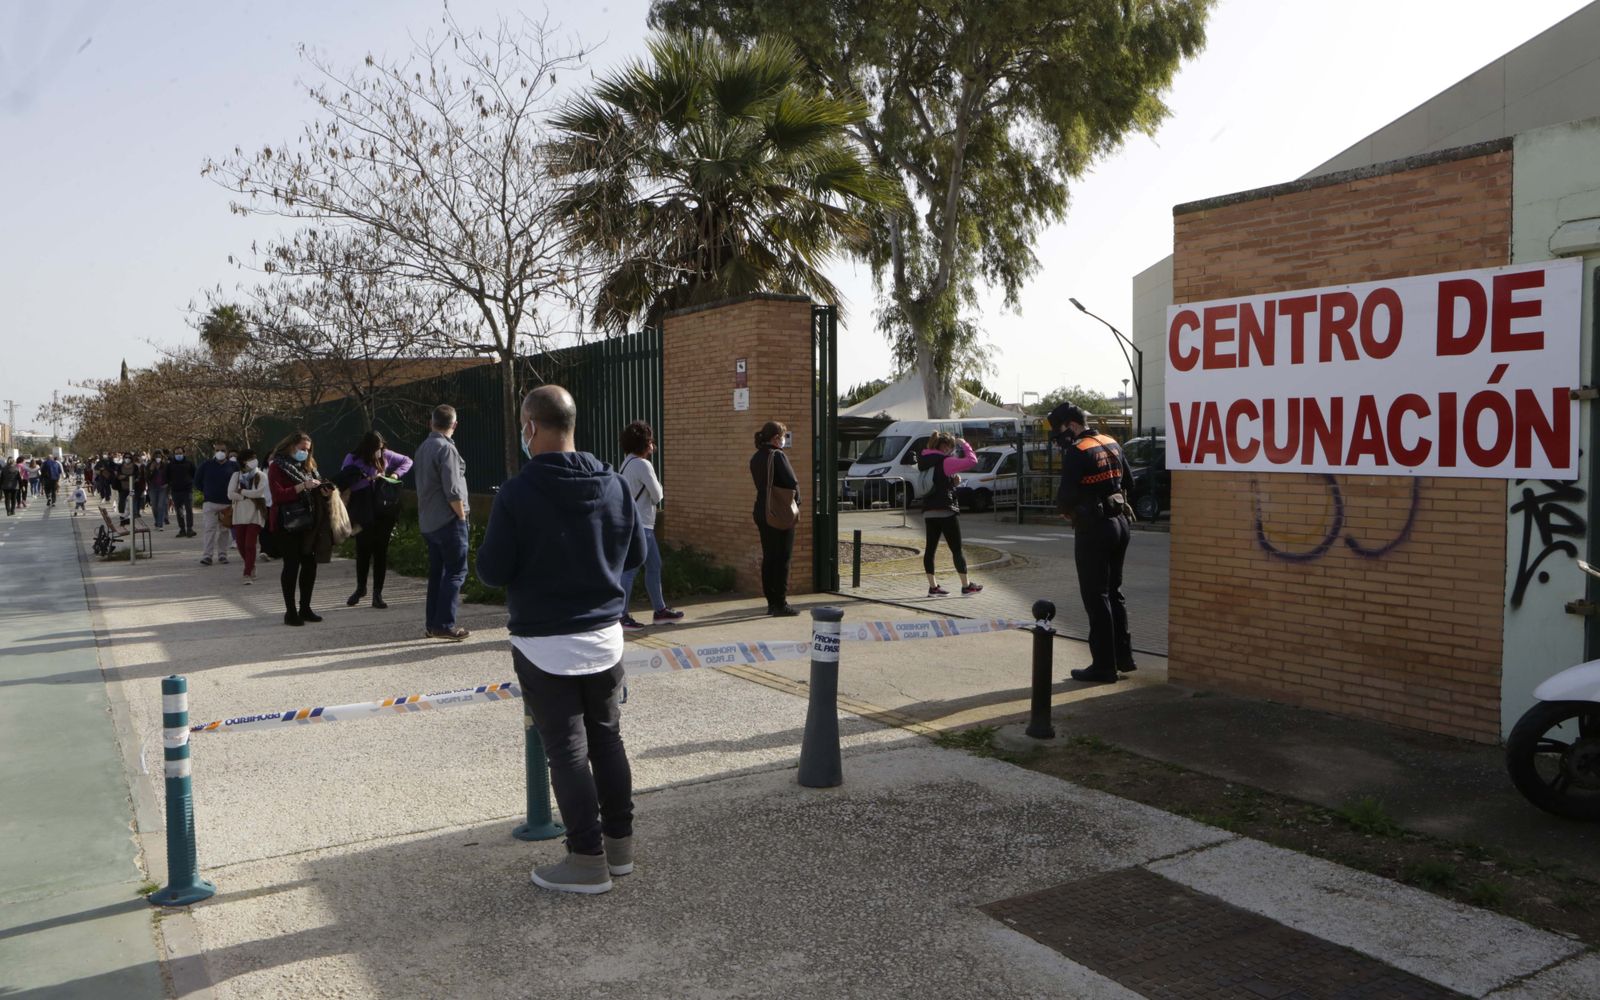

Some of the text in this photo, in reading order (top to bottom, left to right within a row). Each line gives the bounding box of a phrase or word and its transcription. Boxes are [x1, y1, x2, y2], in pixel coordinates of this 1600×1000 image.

[1168, 269, 1546, 372] CENTRO DE
[1169, 363, 1571, 469] VACUNACIÓN
[814, 642, 822, 651] EL
